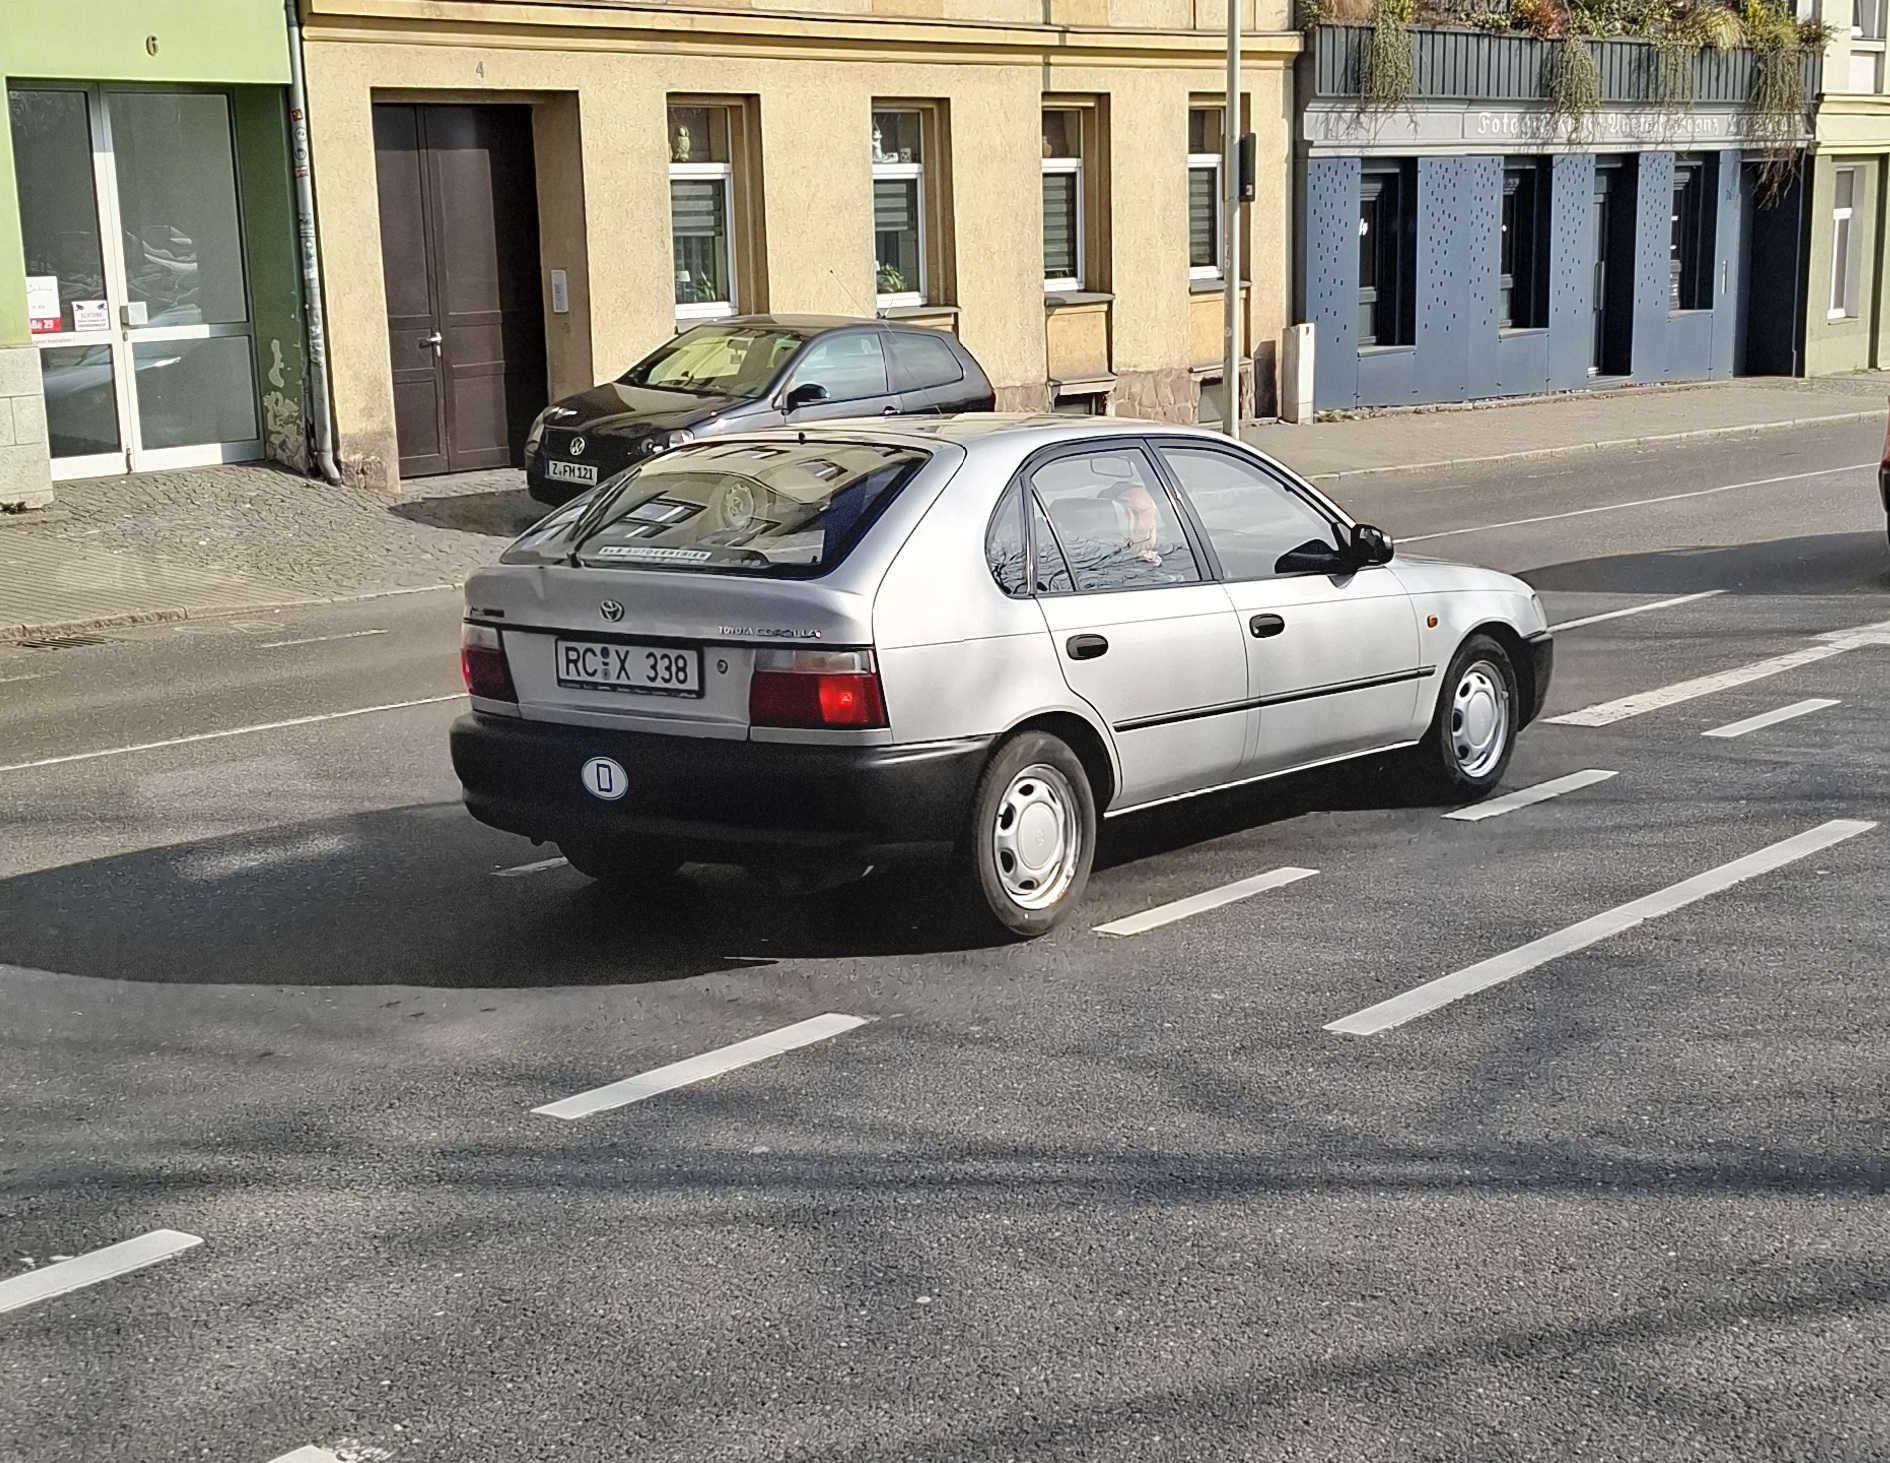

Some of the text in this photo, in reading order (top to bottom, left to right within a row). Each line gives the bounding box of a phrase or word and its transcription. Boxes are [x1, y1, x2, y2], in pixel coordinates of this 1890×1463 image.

[146, 35, 159, 57] 6
[475, 61, 485, 79] 4
[43, 319, 53, 328] 29
[718, 625, 821, 639] TOYOTA COROLLA
[564, 645, 689, 685] RC X 338
[596, 763, 613, 793] D
